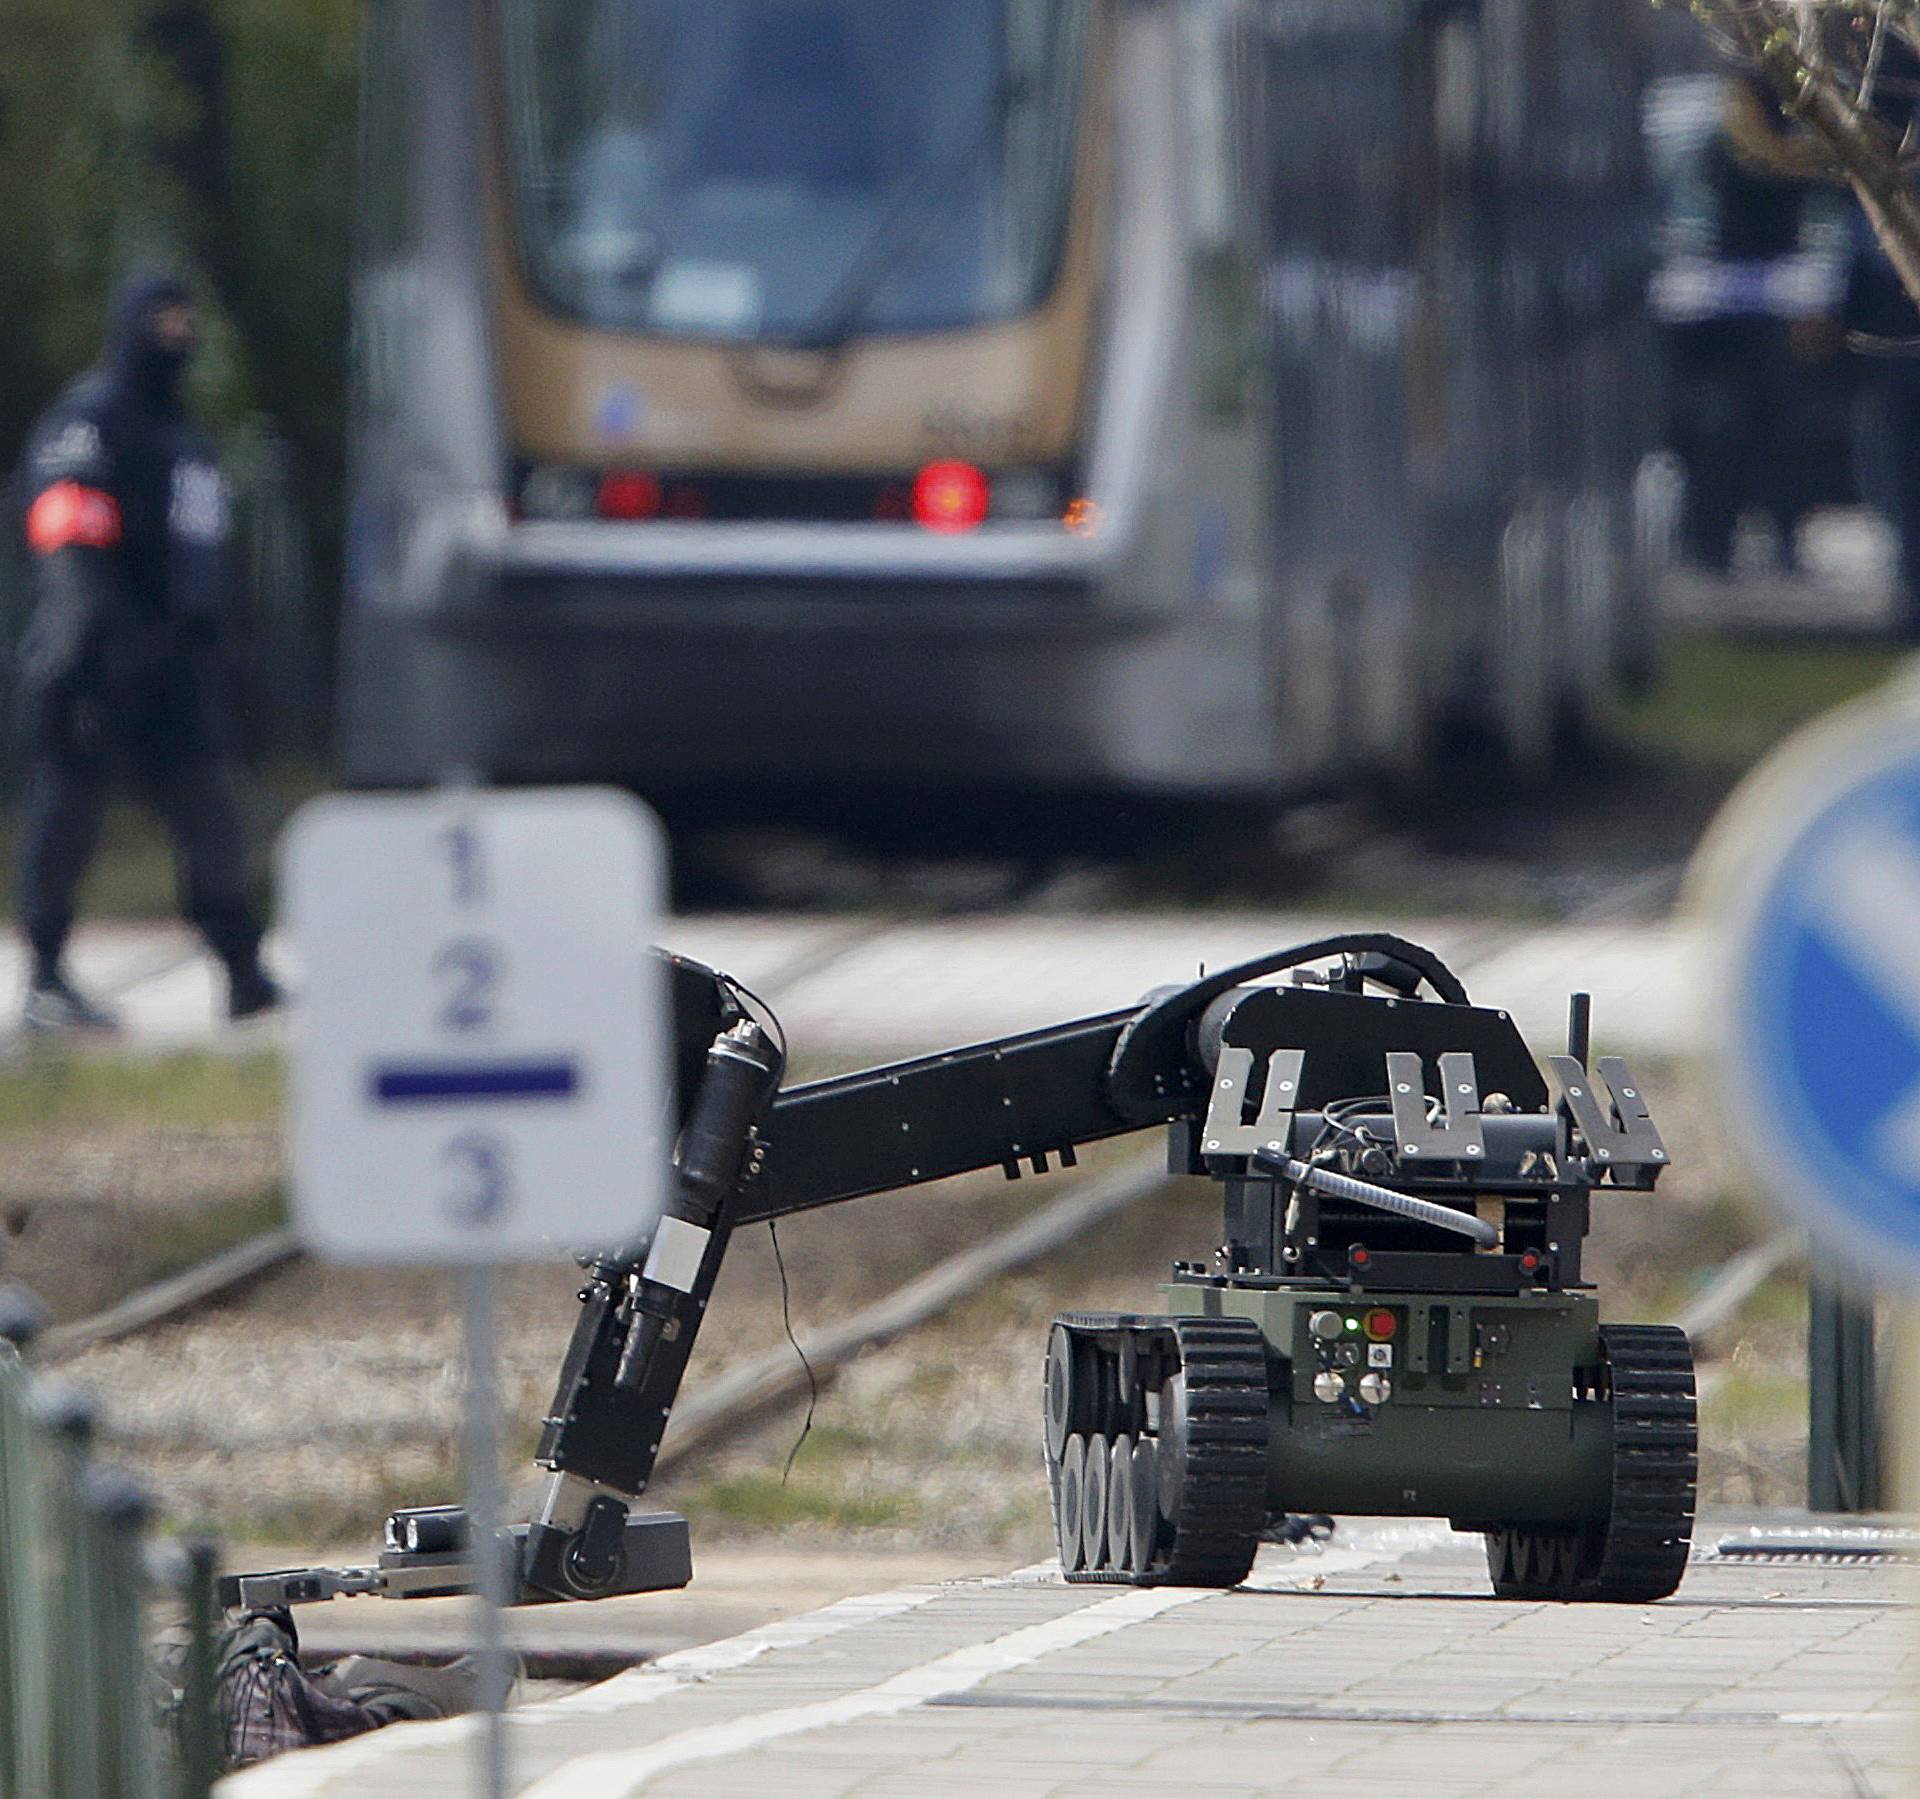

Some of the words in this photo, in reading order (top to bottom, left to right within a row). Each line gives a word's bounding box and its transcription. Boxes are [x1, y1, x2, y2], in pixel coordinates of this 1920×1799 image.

[437, 822, 489, 906] 1
[432, 935, 500, 1032] 2
[439, 1129, 511, 1229] 3
